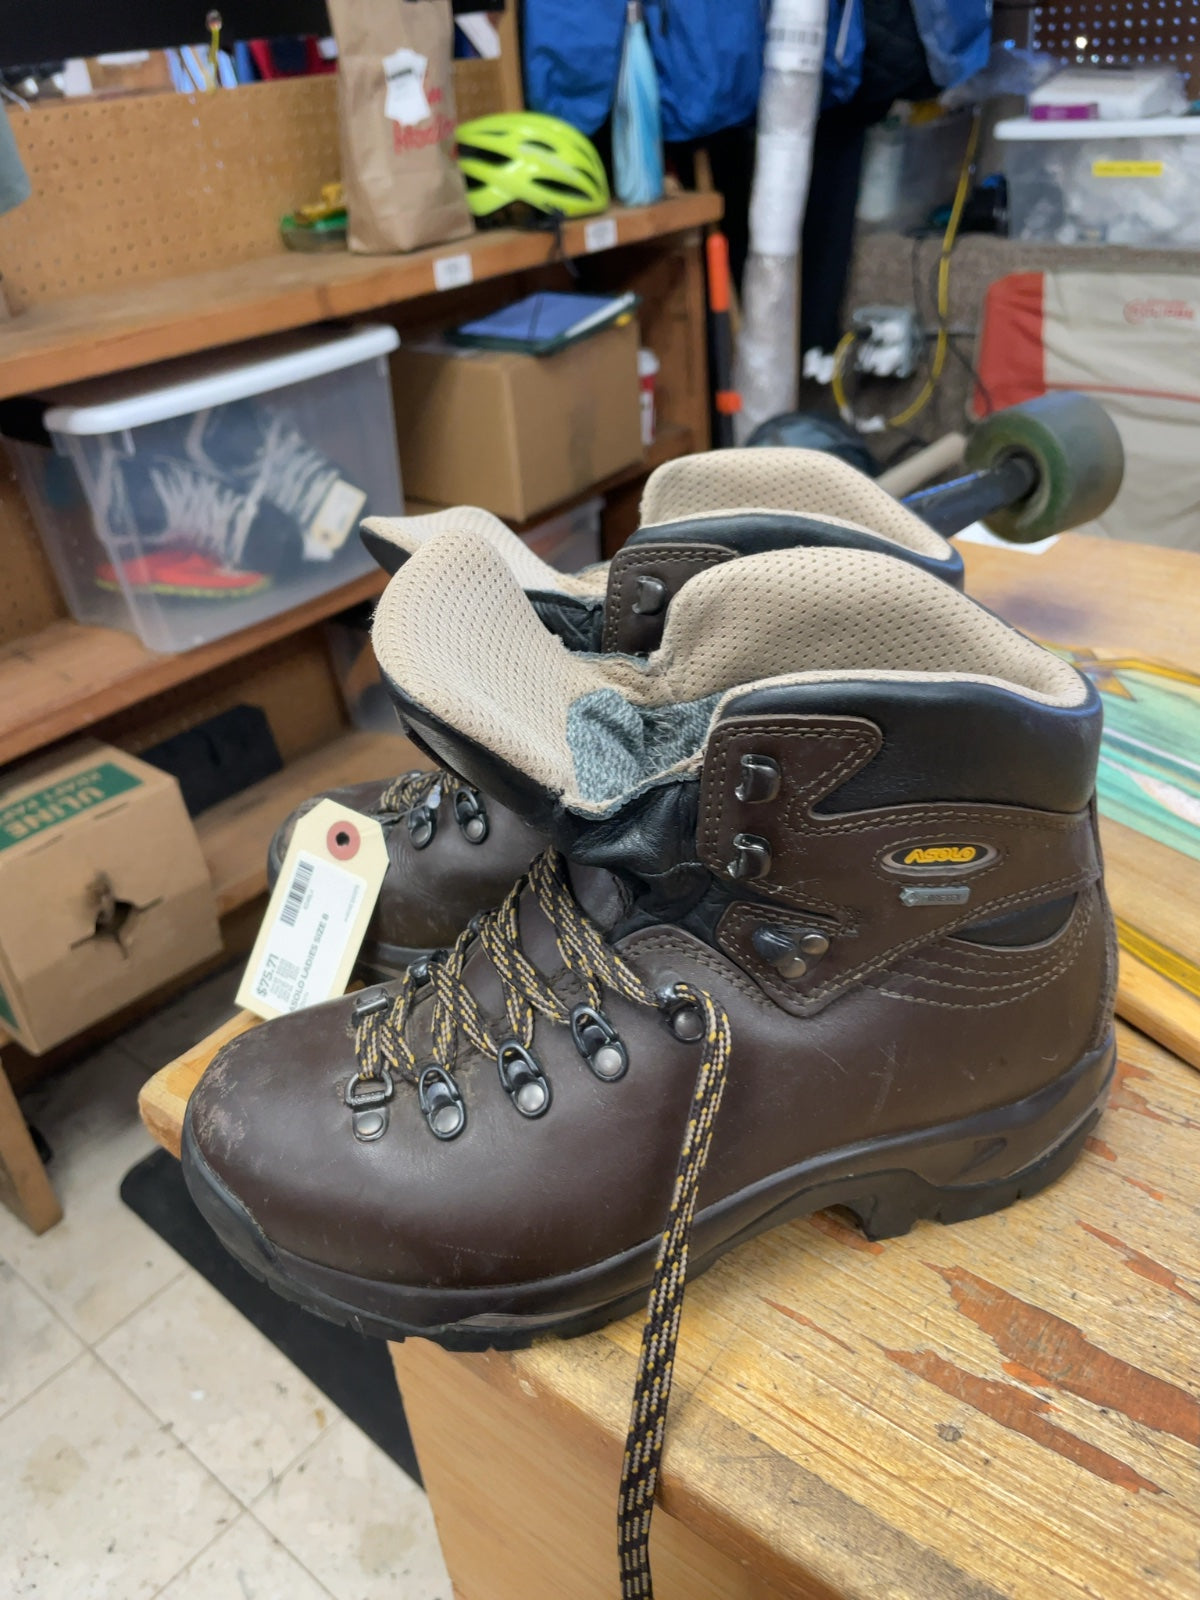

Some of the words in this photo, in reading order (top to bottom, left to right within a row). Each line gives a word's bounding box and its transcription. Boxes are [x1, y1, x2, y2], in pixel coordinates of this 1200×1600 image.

[4, 786, 104, 838] ULINE
[904, 846, 976, 864] ASOLO
[256, 953, 279, 998] $75.71
[288, 980, 306, 1011] ASOLO
[301, 944, 318, 980] LADIES
[314, 922, 325, 944] SIZE
